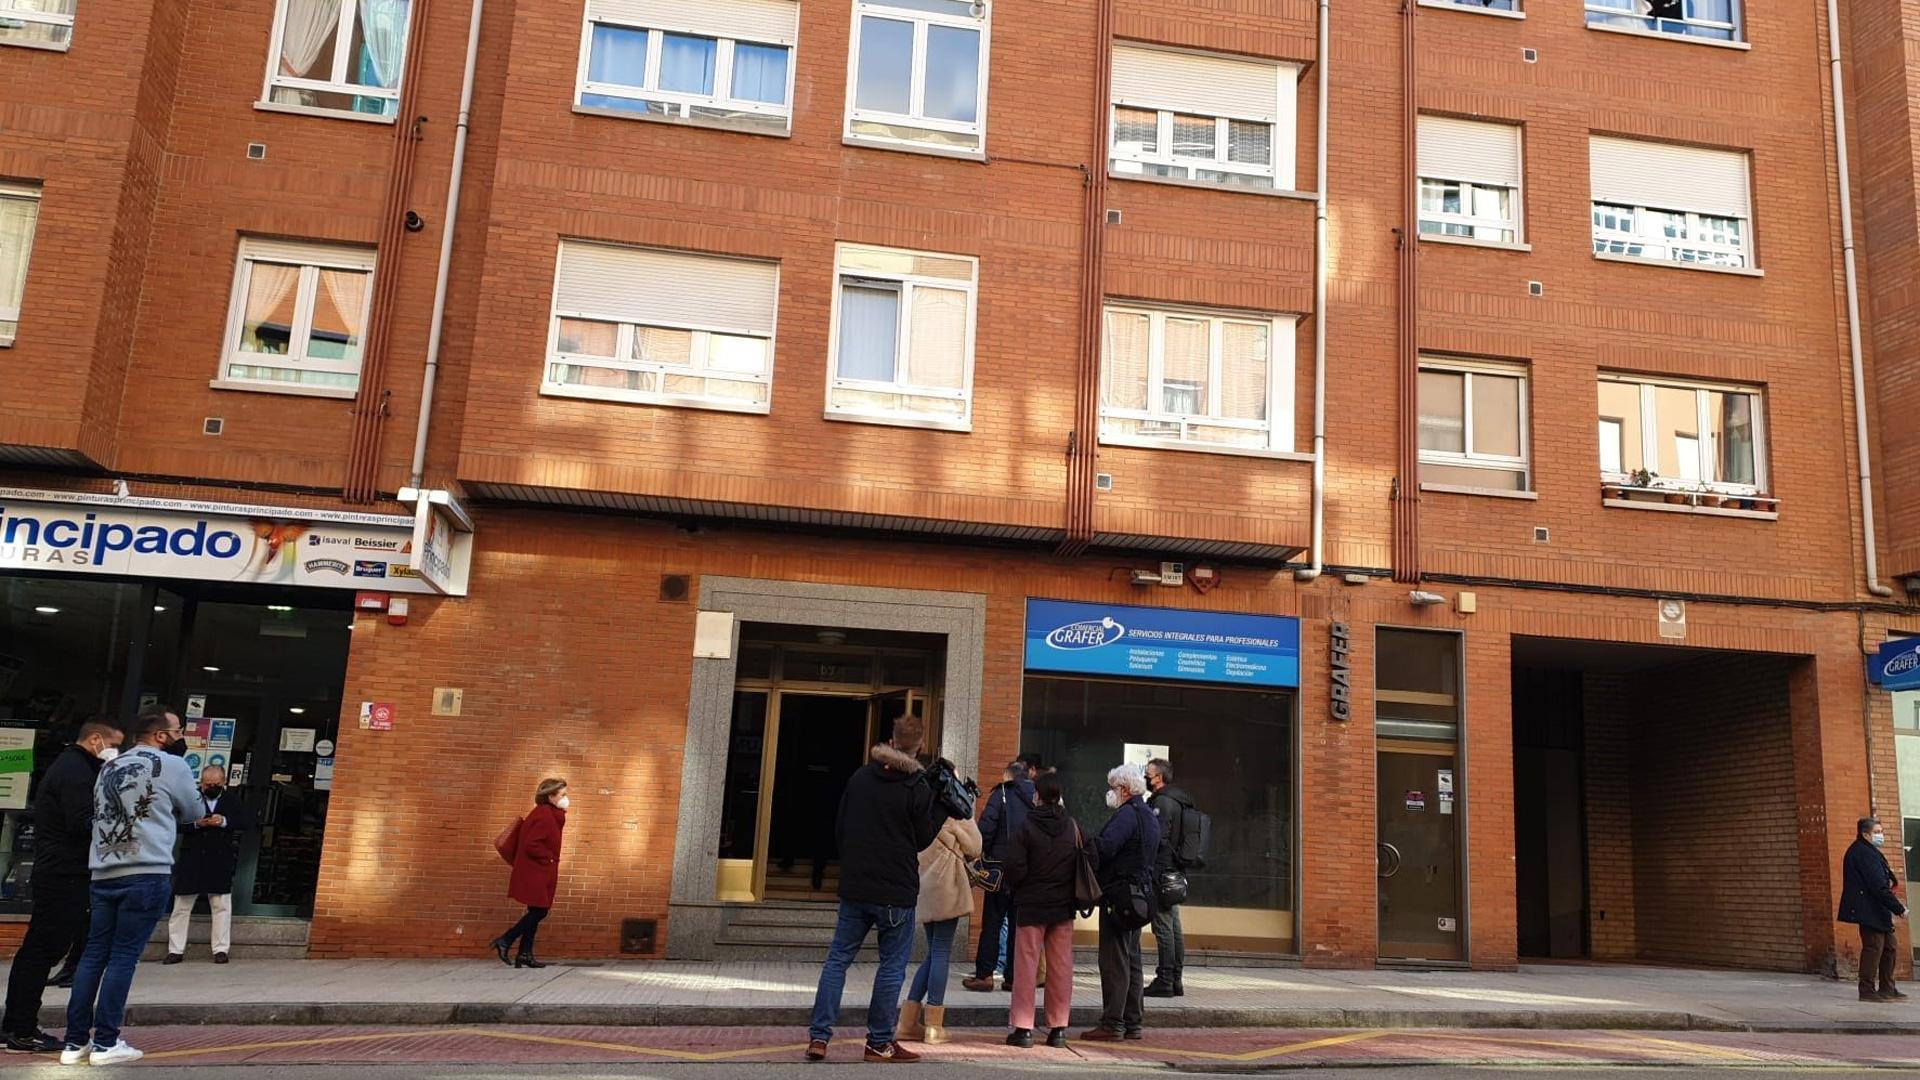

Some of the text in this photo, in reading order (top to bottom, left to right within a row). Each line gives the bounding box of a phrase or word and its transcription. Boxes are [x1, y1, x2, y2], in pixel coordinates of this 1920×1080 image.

[53, 492, 182, 508] www.pinturasprincipado.com
[190, 502, 313, 517] www.pinturasprincipado.com
[322, 535, 398, 548] isaval Beissier
[307, 559, 347, 572] HAMMERITE
[1055, 629, 1104, 645] GRAFER
[1128, 629, 1279, 647] SERVICIOS INTEGRALES PARA PROFESIONALES
[1330, 621, 1350, 720] GRAFER
[1889, 656, 1919, 672] GRAFER
